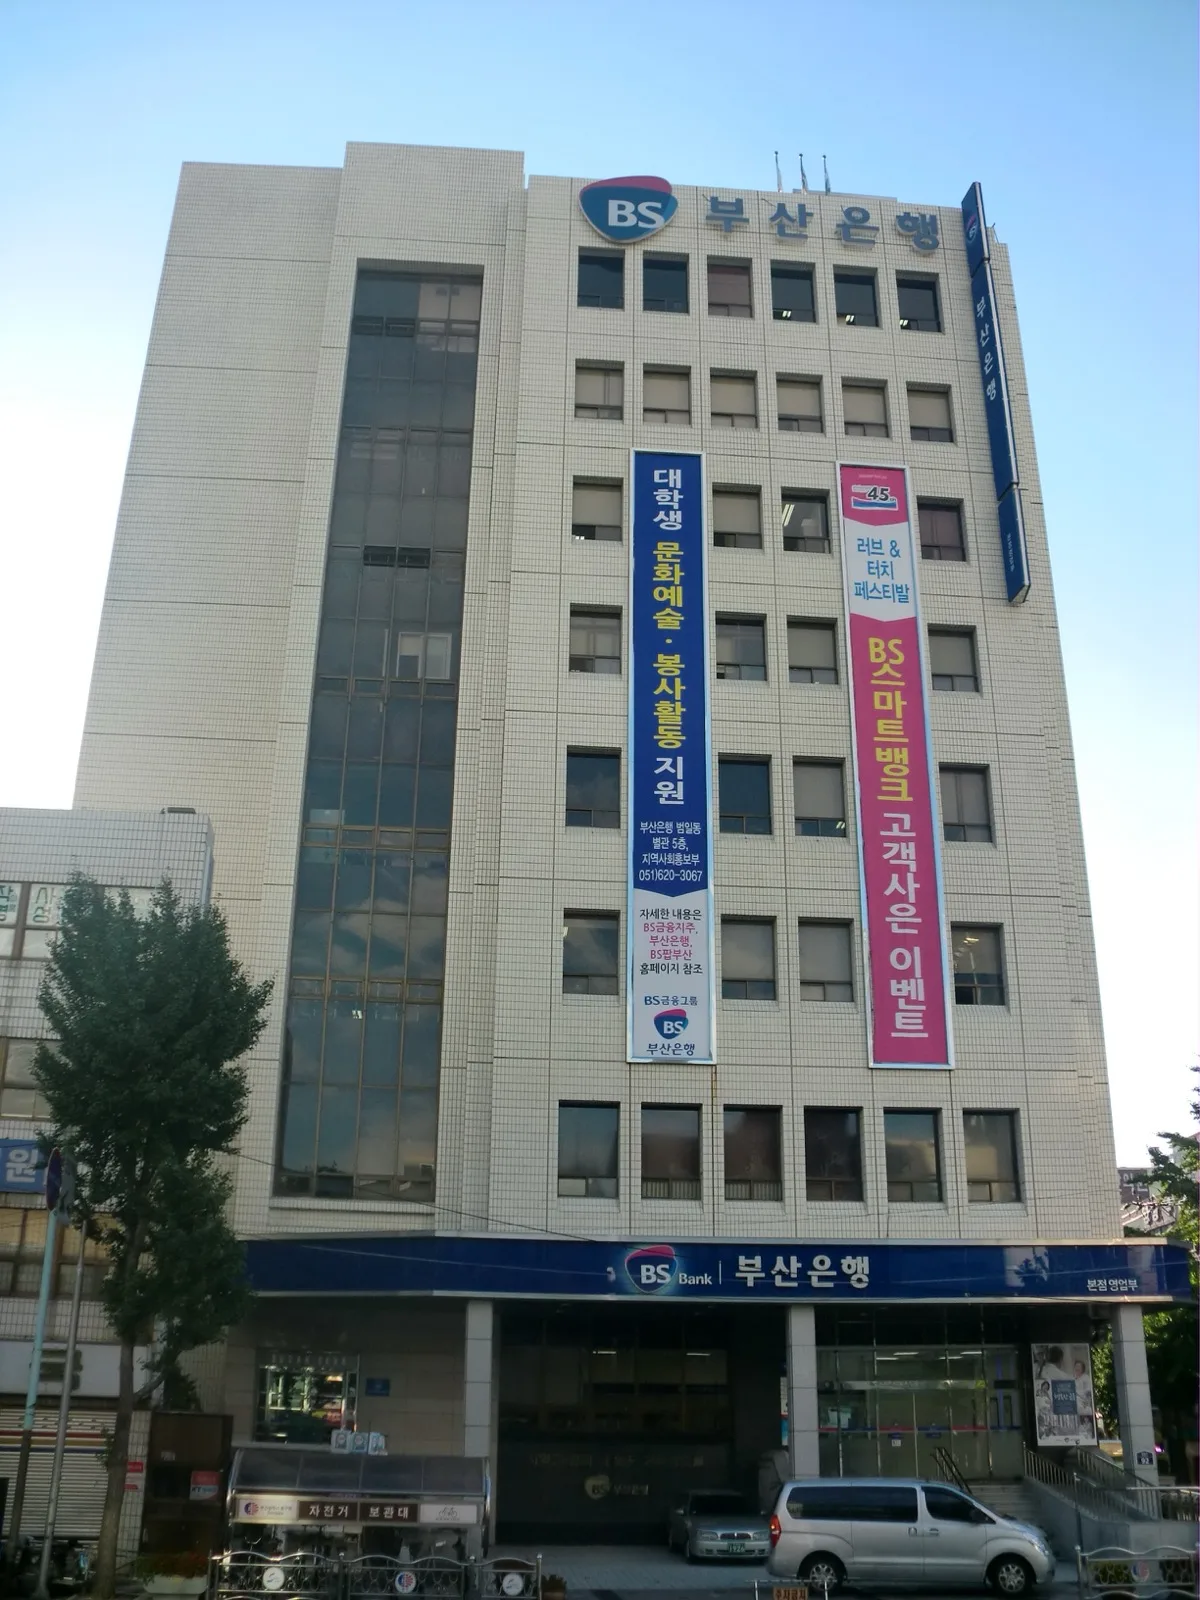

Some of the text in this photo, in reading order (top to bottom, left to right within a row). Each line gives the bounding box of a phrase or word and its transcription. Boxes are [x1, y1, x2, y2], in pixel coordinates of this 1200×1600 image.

[608, 199, 665, 229] BS
[705, 196, 940, 255] 부산은행
[976, 296, 996, 401] 부산은행
[653, 468, 684, 531] 대학생
[867, 486, 889, 502] 45
[857, 537, 901, 558] 러브 &
[867, 560, 894, 580] 터치
[854, 581, 909, 604] 페스티발
[653, 756, 685, 805] 지원
[640, 821, 702, 836] 부산은행 범일동
[868, 637, 929, 1038] BS스마트뱅크 고객사은 이벤트
[652, 836, 670, 850] 별관
[639, 908, 702, 921] 자세한 내용은
[639, 962, 703, 975] 홈페이지 참조
[644, 995, 698, 1007] BS금융그룹
[663, 1020, 684, 1035] BS
[646, 1043, 696, 1057] 부산은행
[640, 1254, 871, 1290] BS Bank 부산은행
[1086, 1278, 1139, 1292] 본점 영업부
[309, 1503, 349, 1518] 자전거
[369, 1506, 409, 1519] 보관대
